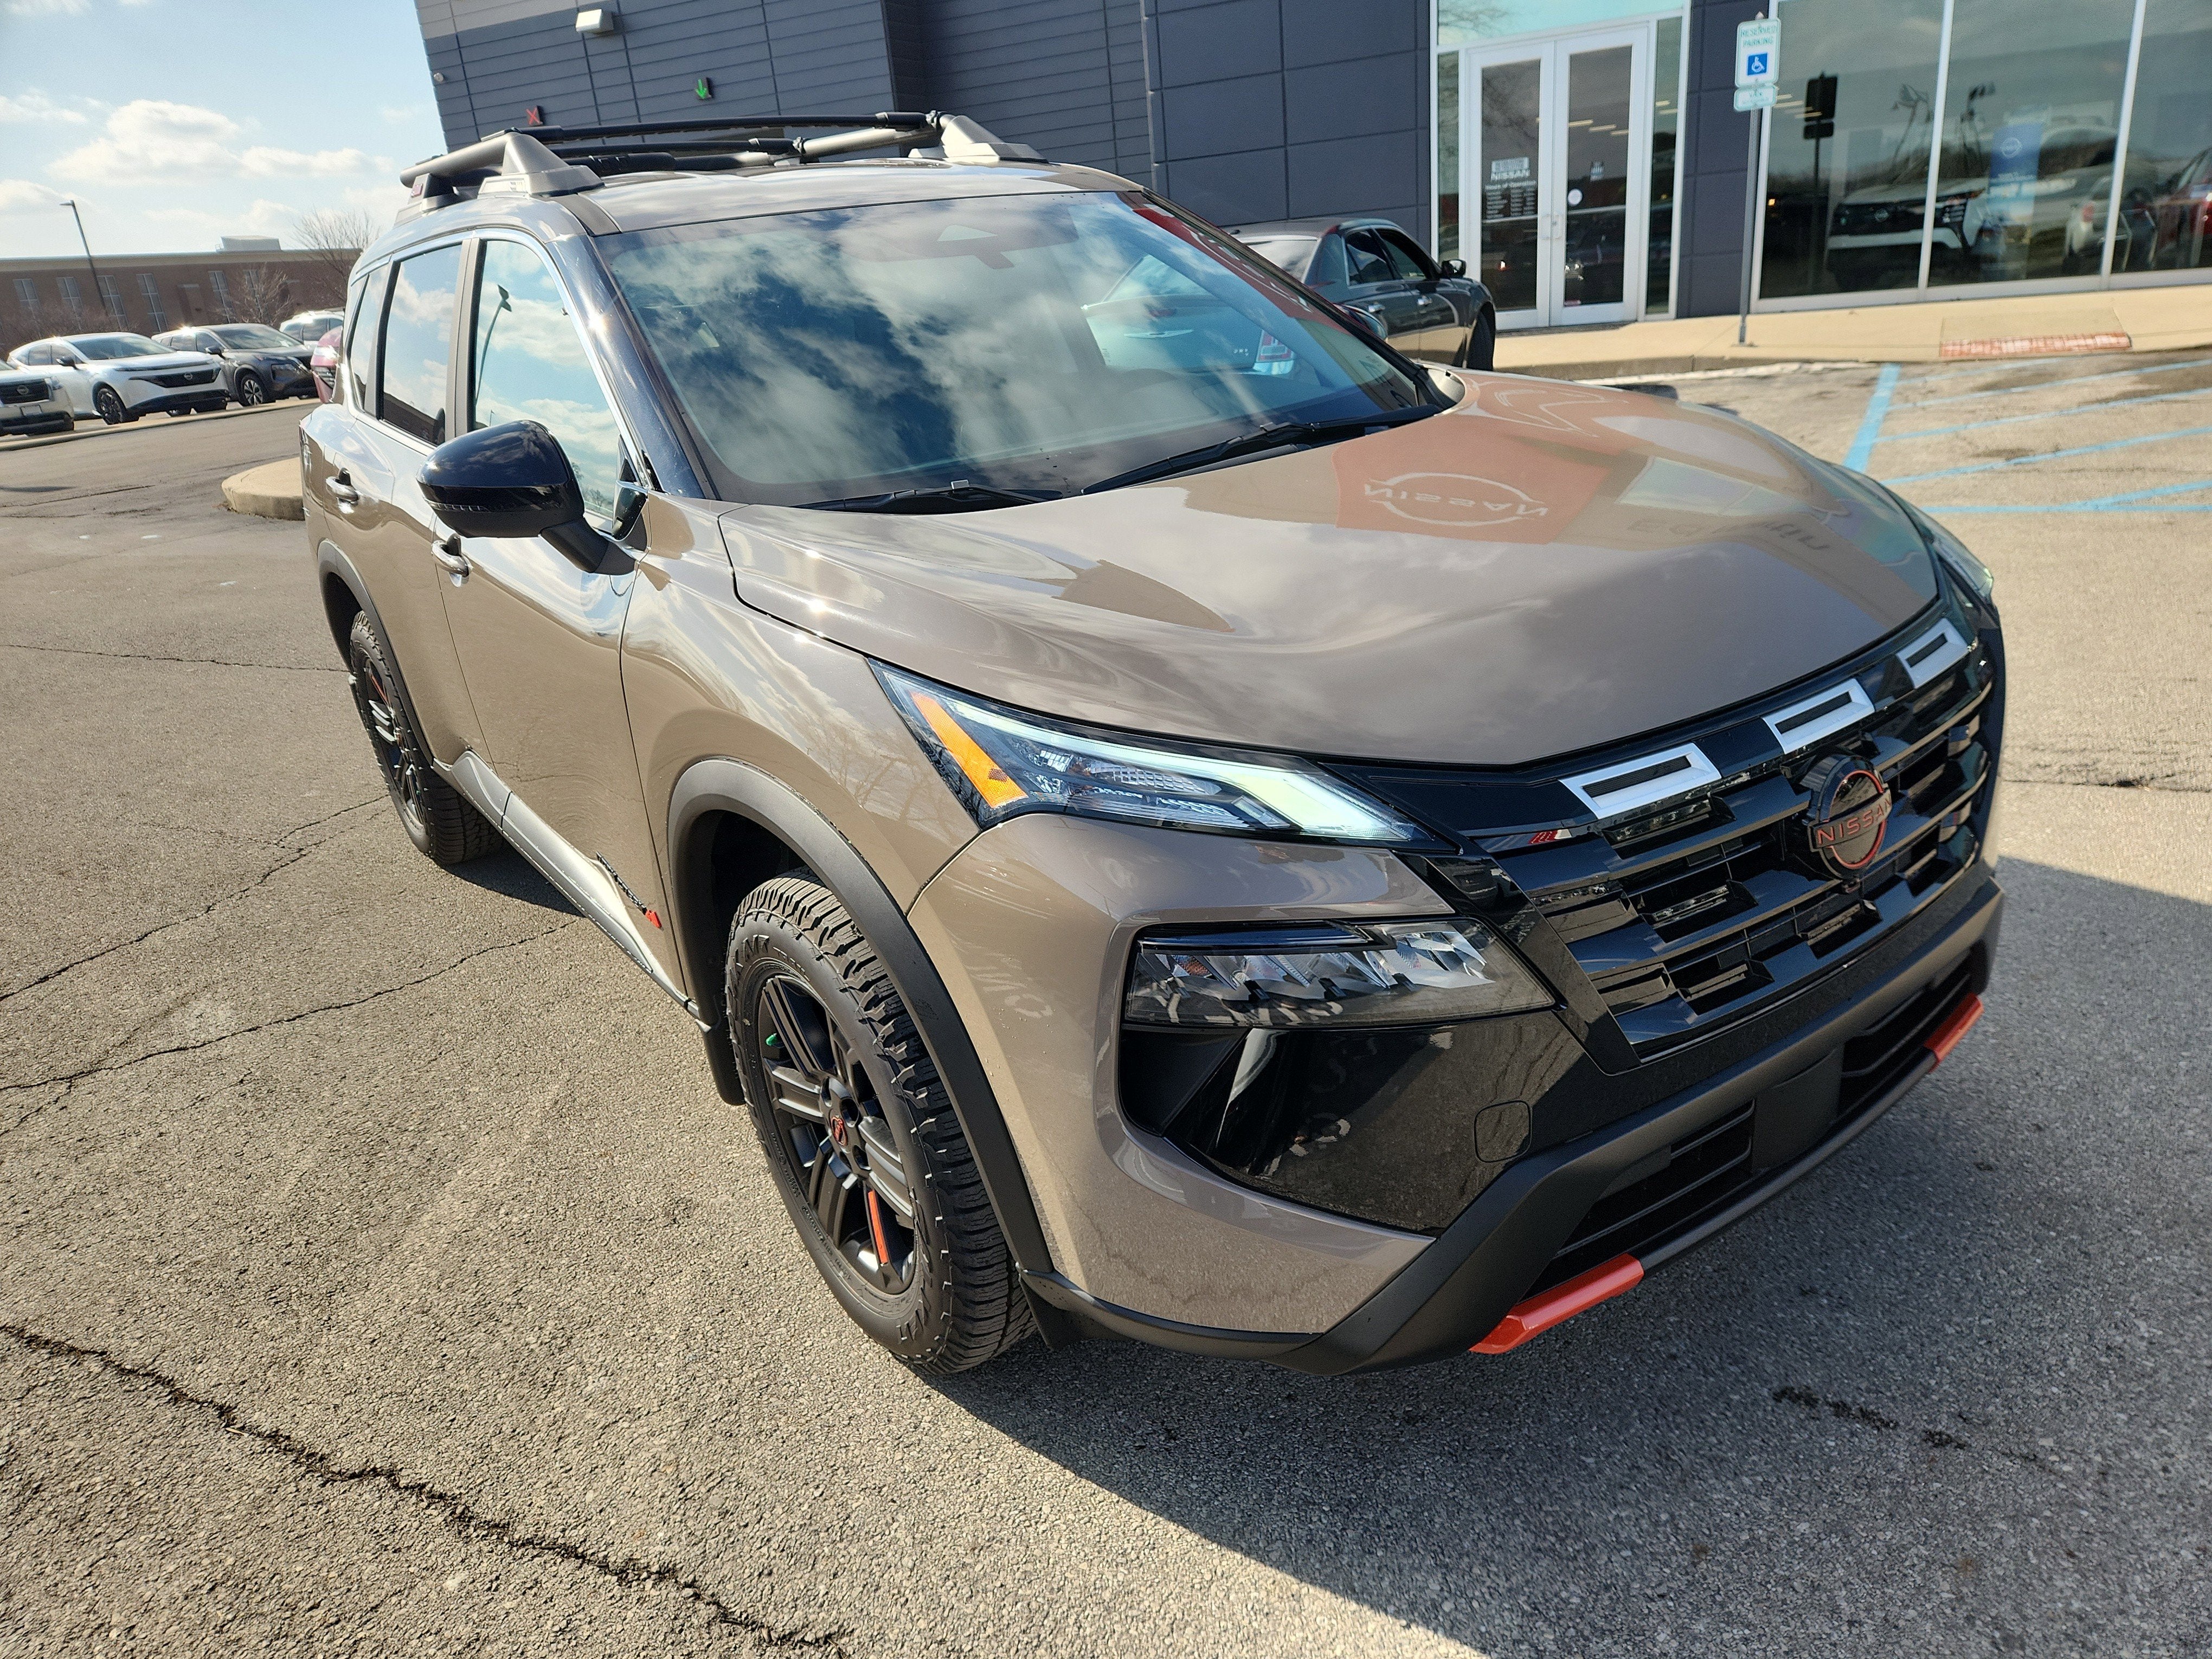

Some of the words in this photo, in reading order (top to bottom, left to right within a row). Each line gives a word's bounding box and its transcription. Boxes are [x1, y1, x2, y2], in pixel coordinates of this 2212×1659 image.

[1740, 25, 1778, 37] RESERVED
[1742, 37, 1773, 47] PARKING
[1816, 799, 1892, 846] NISSAN
